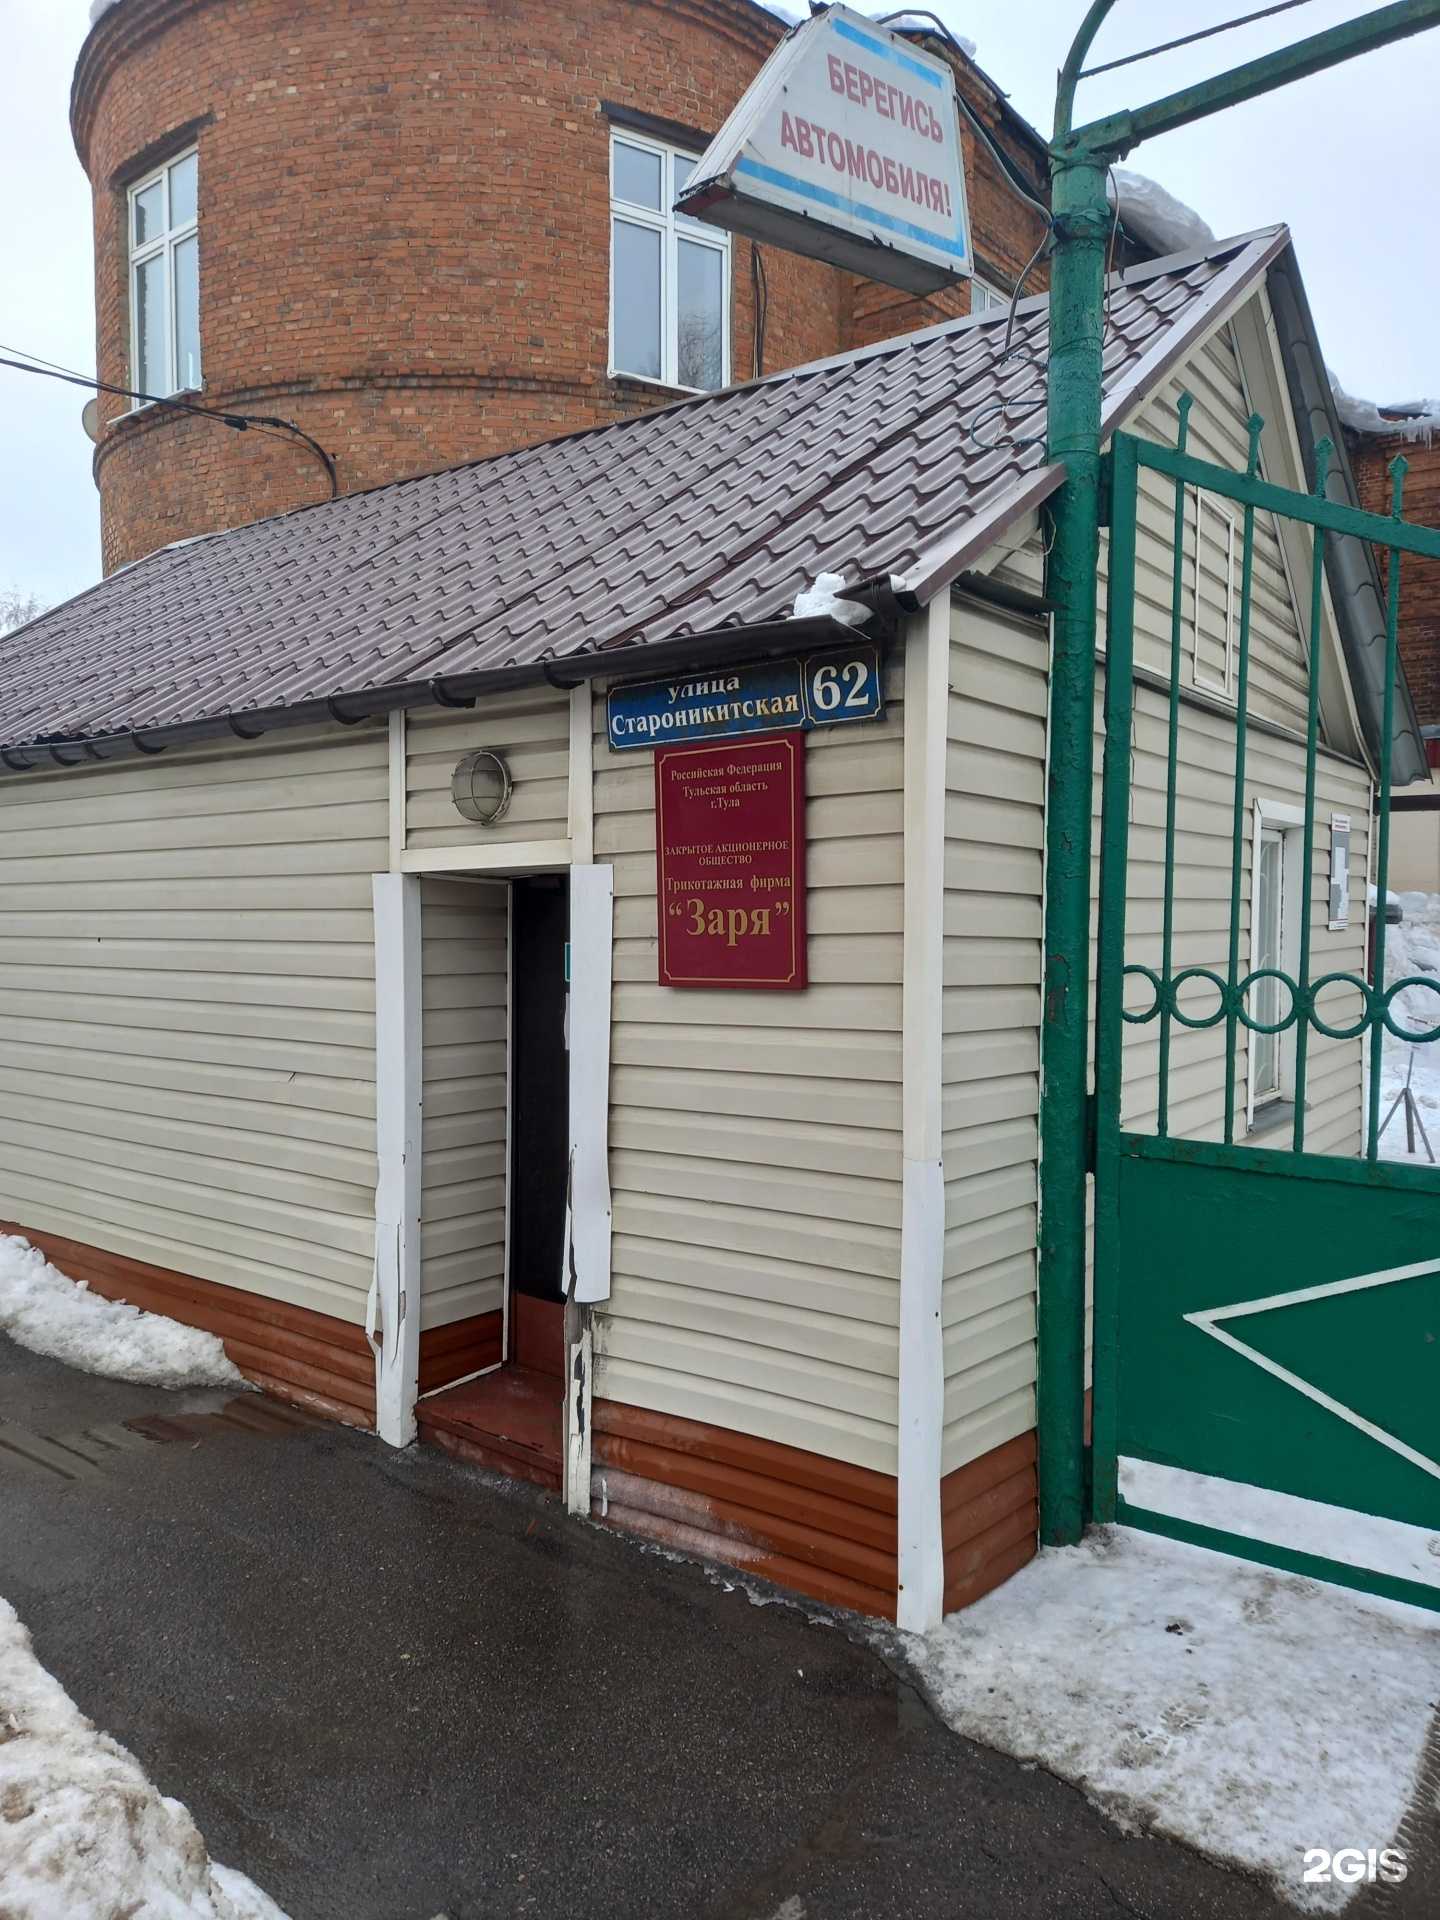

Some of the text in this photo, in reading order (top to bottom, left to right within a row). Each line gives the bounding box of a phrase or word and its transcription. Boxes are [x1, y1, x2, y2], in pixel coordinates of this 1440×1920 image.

[827, 54, 943, 143] БЕРЕГИСЬ
[781, 111, 952, 217] АВТОМОБИЛЯ!
[668, 676, 740, 704] улица
[813, 661, 869, 710] 62
[612, 694, 799, 736] Староникитская
[671, 761, 782, 781] Российская Федерация
[683, 781, 768, 800] Тульская область
[665, 840, 790, 856] ЗАКРЫТОЕ АКЦИОНЕРНОЕ
[698, 855, 752, 866] ОБЩЕСТВО
[665, 874, 791, 894] Трикотажная фирма
